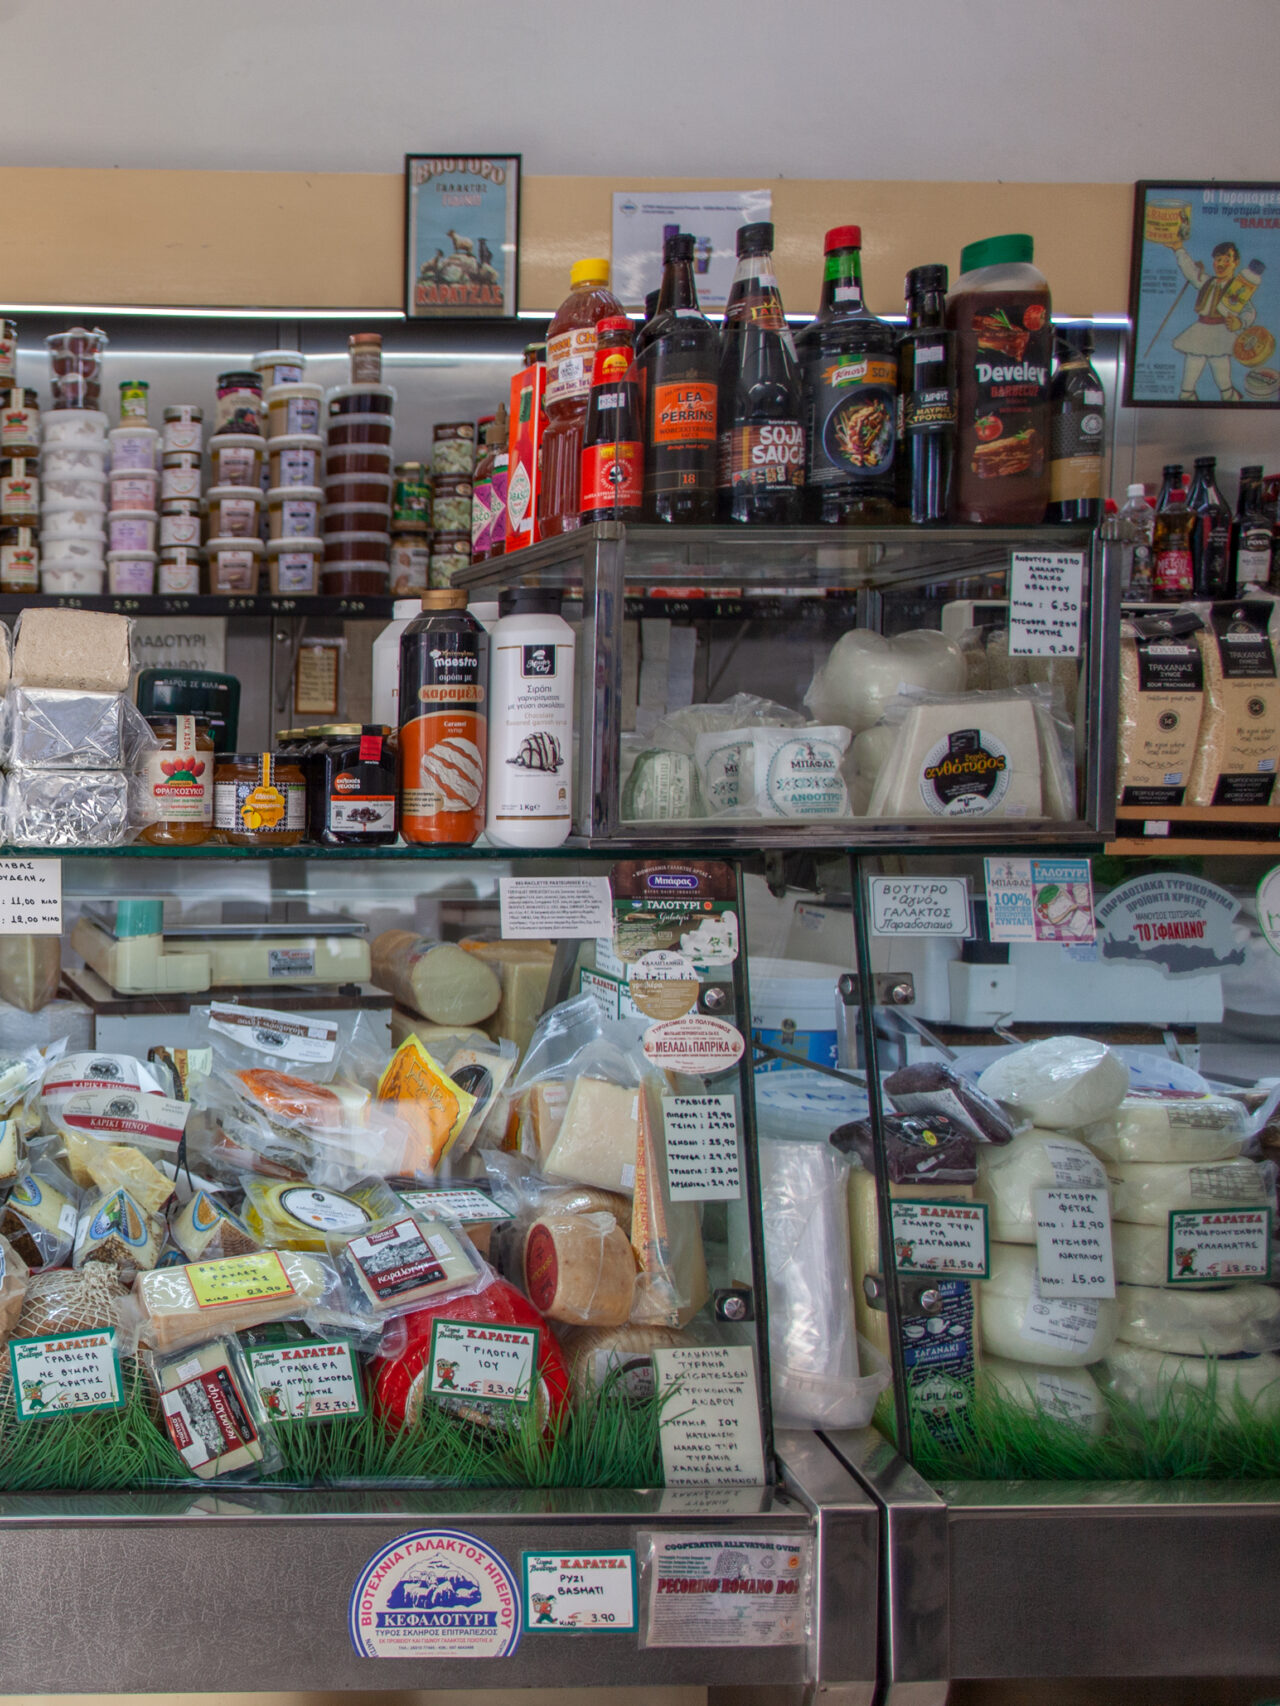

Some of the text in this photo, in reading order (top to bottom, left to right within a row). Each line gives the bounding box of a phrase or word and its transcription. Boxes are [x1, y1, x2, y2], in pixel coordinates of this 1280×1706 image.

[976, 361, 1047, 385] Develey
[678, 391, 703, 402] LEA
[661, 410, 714, 424] PERRINS
[759, 426, 803, 445] SOJA
[752, 445, 805, 465] SAUCE
[133, 633, 207, 649] ΛΑΔΟΤΥΡΙ
[434, 656, 478, 667] maestro
[527, 685, 552, 695] Σιρόπι
[1034, 867, 1088, 878] ΓΑΛΟΤΥΡΙ
[654, 876, 692, 887] Μπάφας
[883, 884, 948, 895] ΒΟΥΤΥΡΟ
[647, 900, 701, 910] ΓΑΛΟΤΥΡΙ
[994, 892, 1031, 906] 100%
[883, 908, 951, 918] ΓΑΛΑΚΤΟΣ
[655, 1041, 730, 1053] ΜΕΛΑΔΙ ΠΑΠΡΙΚΑ
[920, 1207, 980, 1220] ΚΑΡΑΤΖΑ
[1202, 1214, 1263, 1225] ΚΑΡΑΤΖΑ
[466, 1329, 530, 1345] ΚΑΡΑΤΖΑ
[45, 1337, 108, 1353] ΚΑΡΑΤΖΑ
[45, 1352, 99, 1363] ΓΡΑΒΙΕΡΑ
[281, 1346, 346, 1361] ΚΑΡΑΤΖΑ
[58, 1377, 103, 1389] ΚΡΗΤΗΣ
[560, 1559, 628, 1569] ΚΑΡΑΤΖΑ
[361, 1538, 513, 1629] ΒΙΟΤΕΧΝΙΑ ΓΑΛΑΚΤΟΣ ΗΠΕΙΡΟΥ
[657, 1577, 773, 1595] PECORINO ROMANO
[557, 1586, 604, 1595] BASMATI
[384, 1612, 489, 1627] ΚΕΦΑΛΟΤΥΡΙ
[591, 1613, 616, 1623] 3.90
[376, 1629, 498, 1637] ΤΥΡΟΣ ΣΚΛΗΡΟΣ ΕΠΙΤΡΑΠΕΖΙΟΣ
